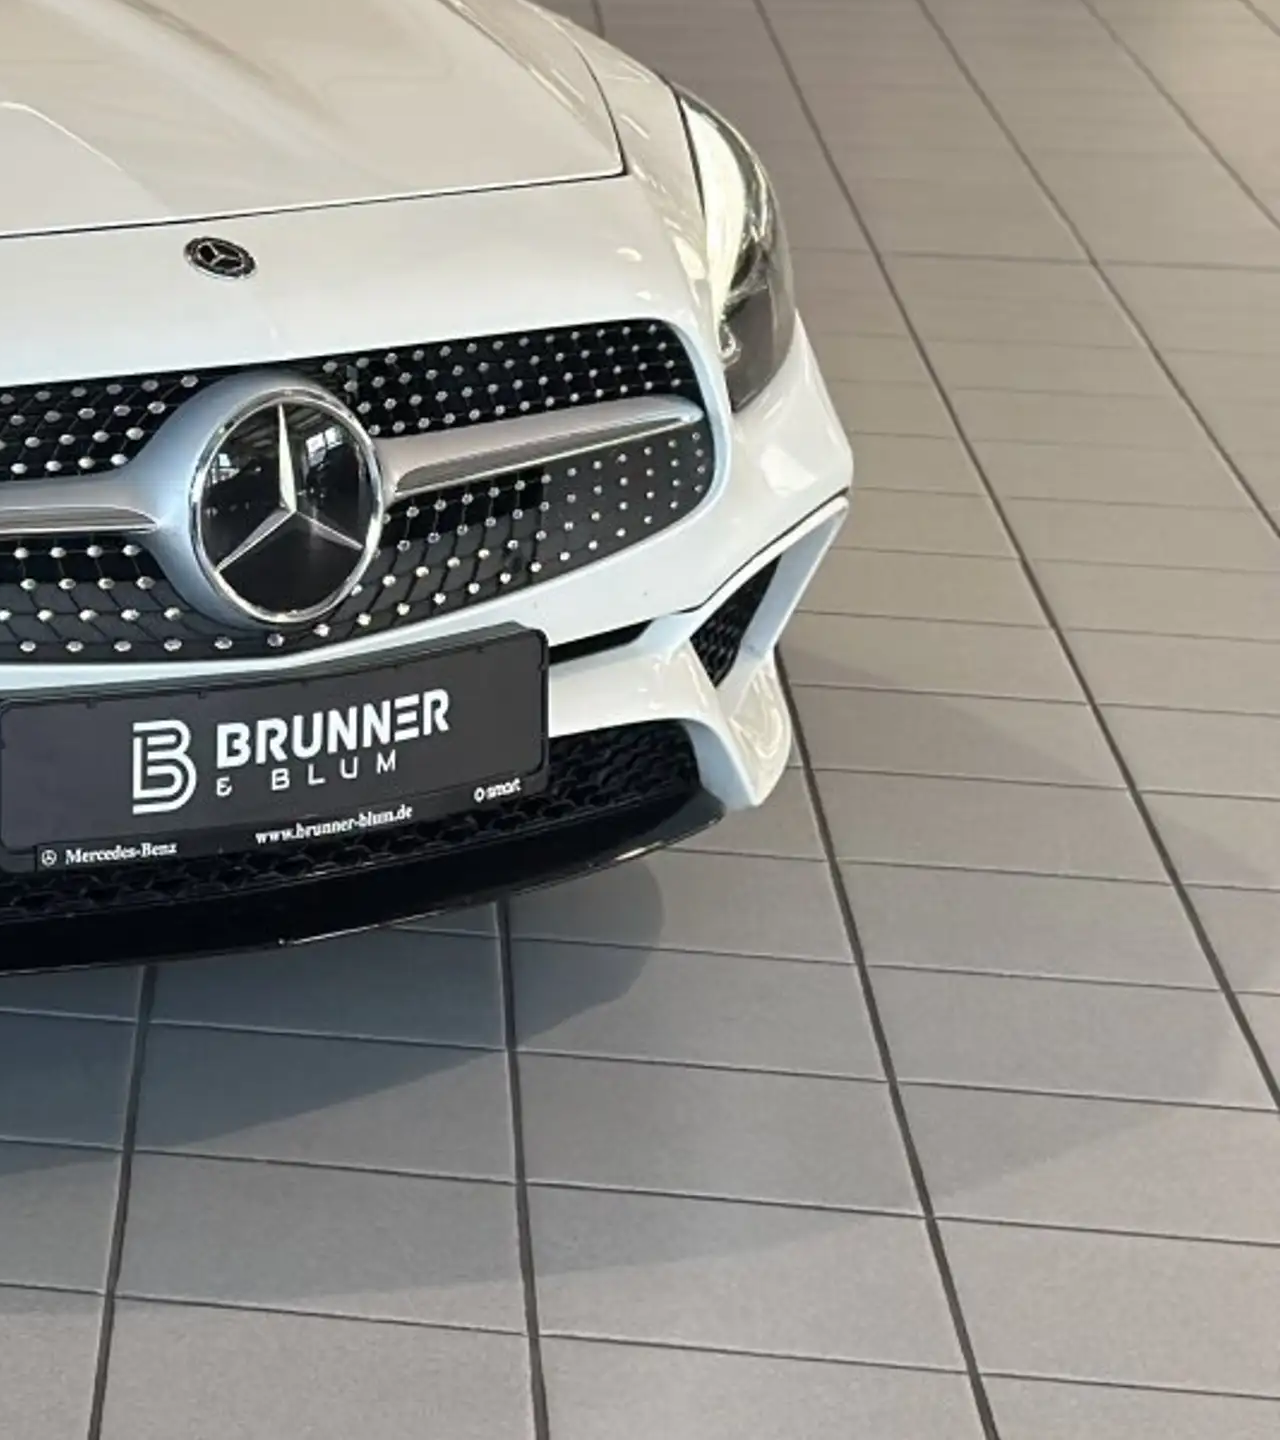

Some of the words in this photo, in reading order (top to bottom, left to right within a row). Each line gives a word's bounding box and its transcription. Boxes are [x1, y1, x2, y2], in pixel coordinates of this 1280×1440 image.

[216, 688, 450, 768] BRUNNER
[216, 776, 234, 797] &
[271, 750, 397, 792] BLUM
[487, 777, 521, 799] smart
[255, 804, 413, 844] www.brunner-blum.de
[66, 841, 178, 866] Mercedes-Benz
